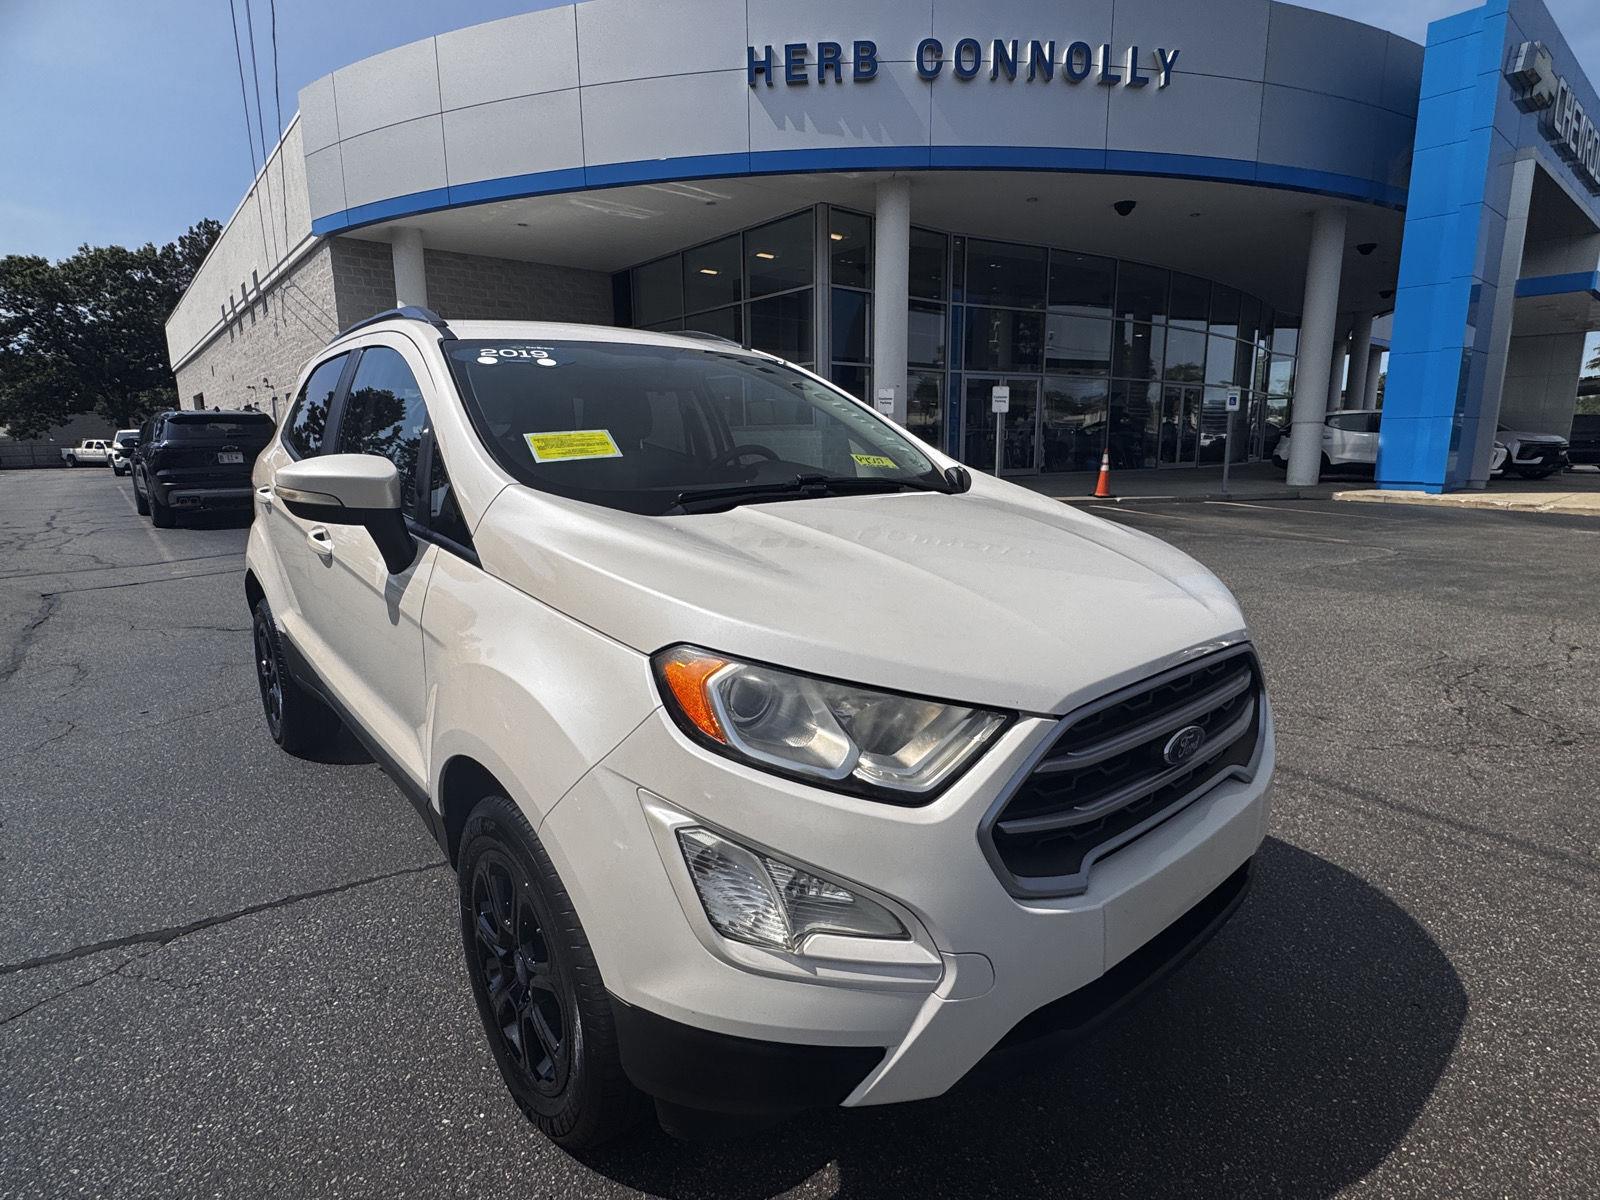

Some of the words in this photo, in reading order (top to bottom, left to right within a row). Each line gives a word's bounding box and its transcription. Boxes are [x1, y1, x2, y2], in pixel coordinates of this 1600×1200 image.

[748, 40, 879, 86] HERB
[915, 38, 1181, 89] CONNOLLY
[479, 348, 549, 359] 2019
